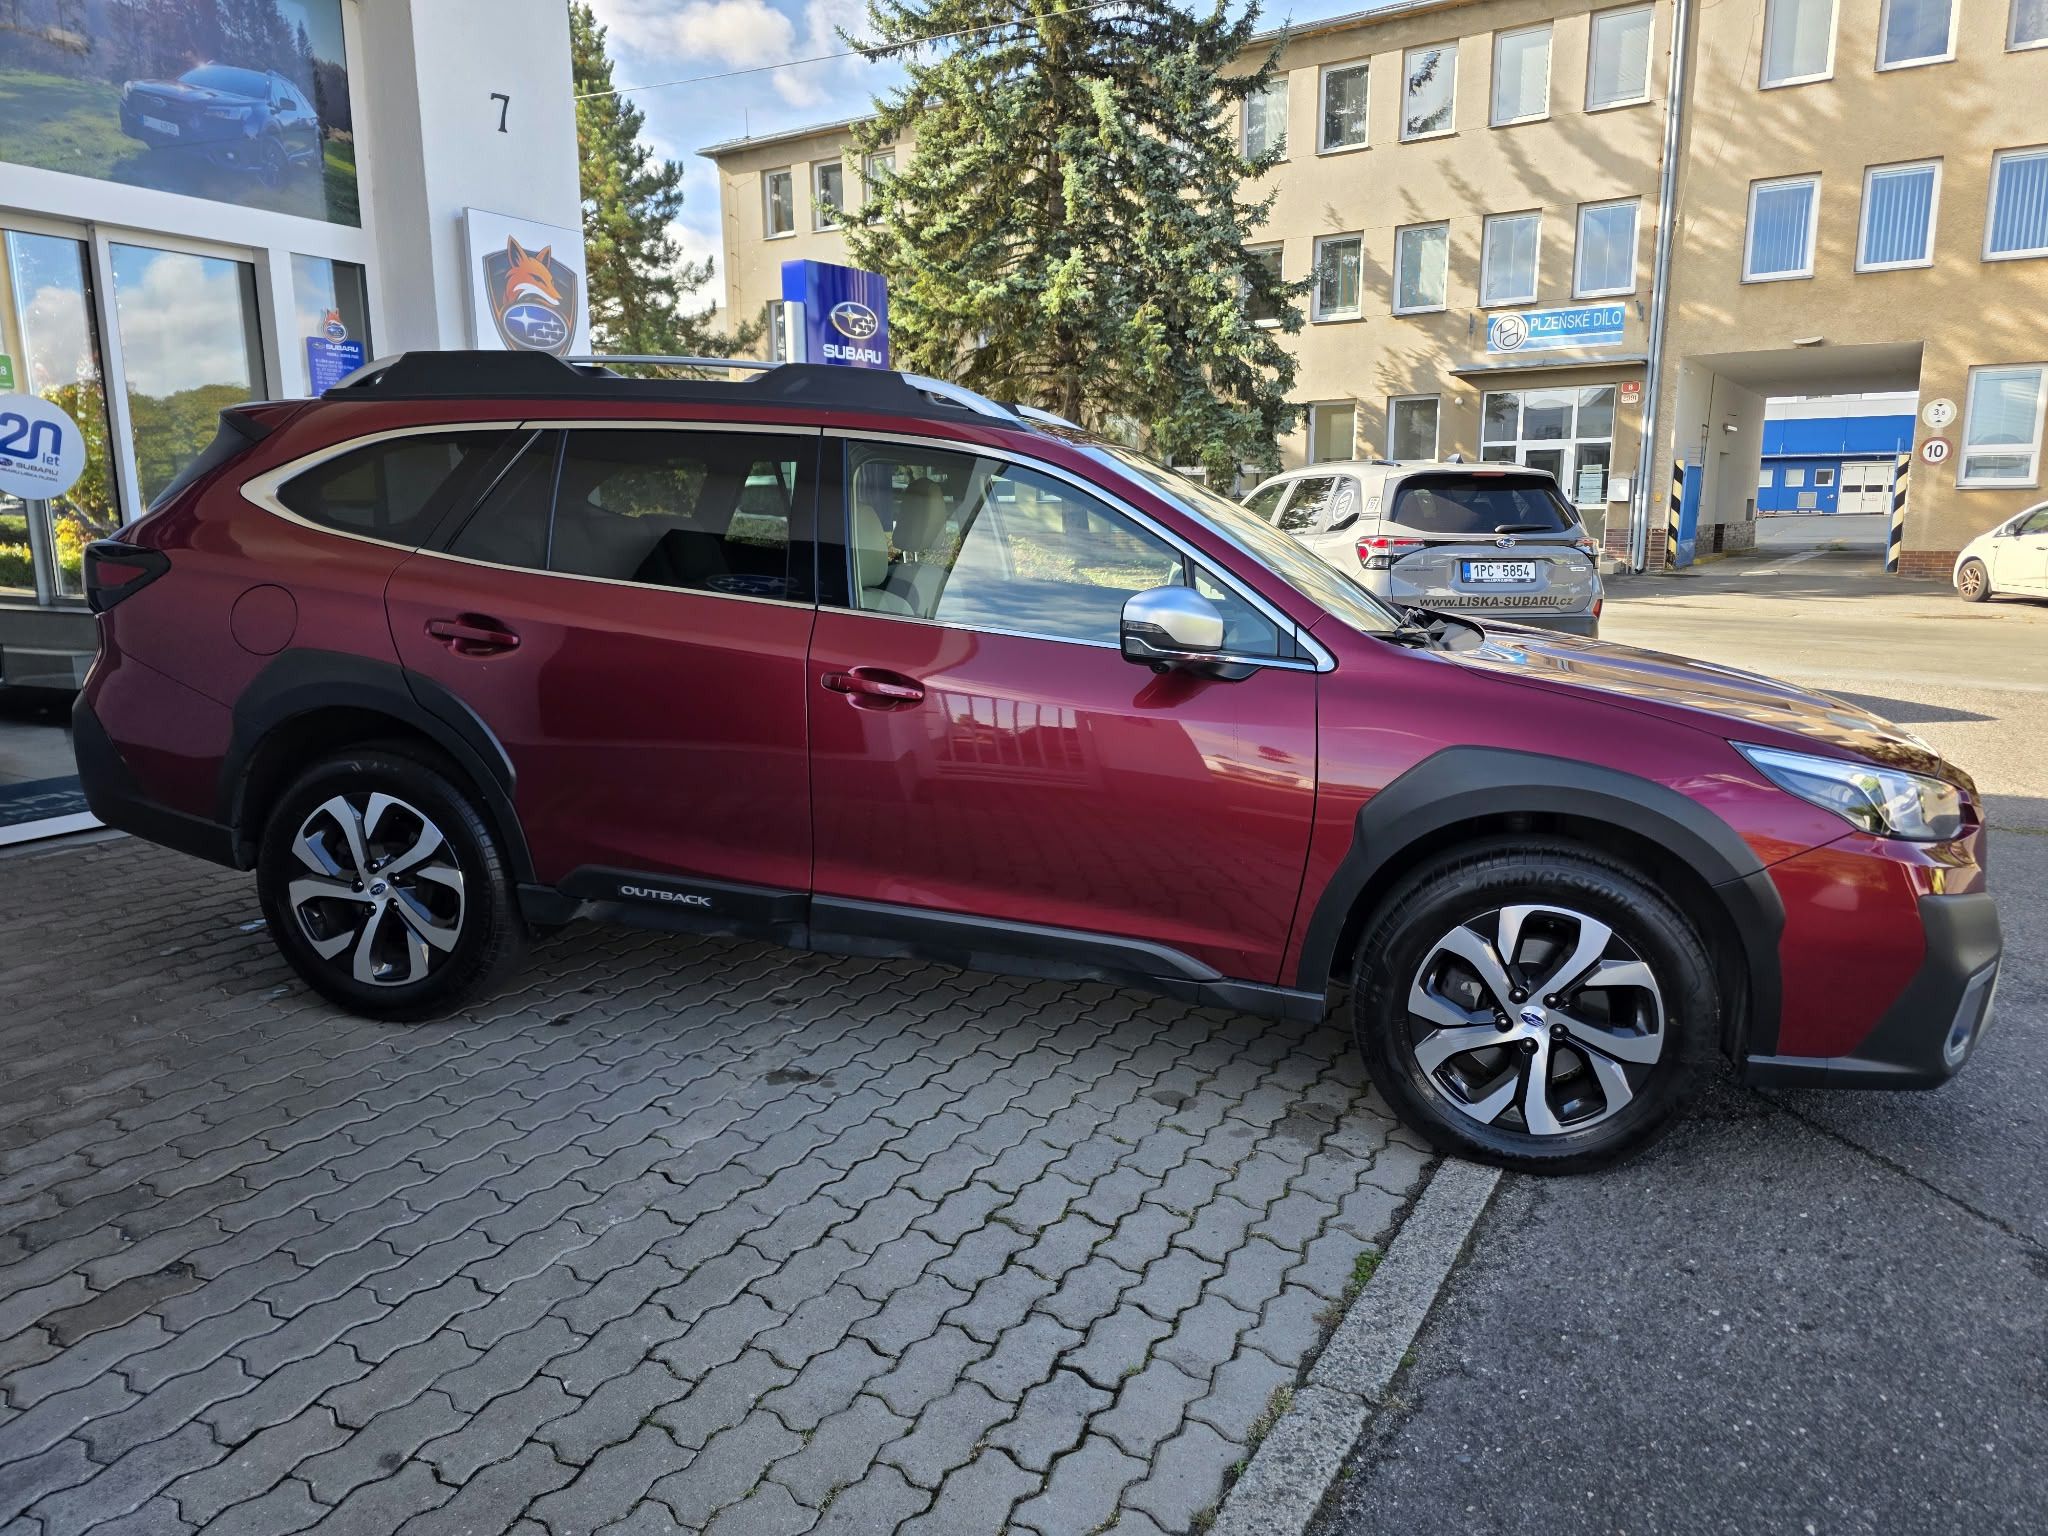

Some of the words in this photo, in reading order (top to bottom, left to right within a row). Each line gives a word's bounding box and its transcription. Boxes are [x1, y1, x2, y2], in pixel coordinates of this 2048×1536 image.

[490, 92, 510, 134] 7
[1530, 311, 1591, 332] PLZEŇSKÉ
[1593, 310, 1622, 327] DÍLO
[325, 343, 359, 353] SUBARU
[822, 343, 882, 365] SUBARU
[1927, 444, 1944, 458] 10
[42, 452, 60, 467] let
[15, 462, 59, 476] SUBARU
[1474, 564, 1494, 577] 1PC
[1502, 564, 1530, 577] 5854
[1419, 596, 1574, 607] www.LISKA-SUBARU.cz
[620, 885, 712, 907] OUTBACK
